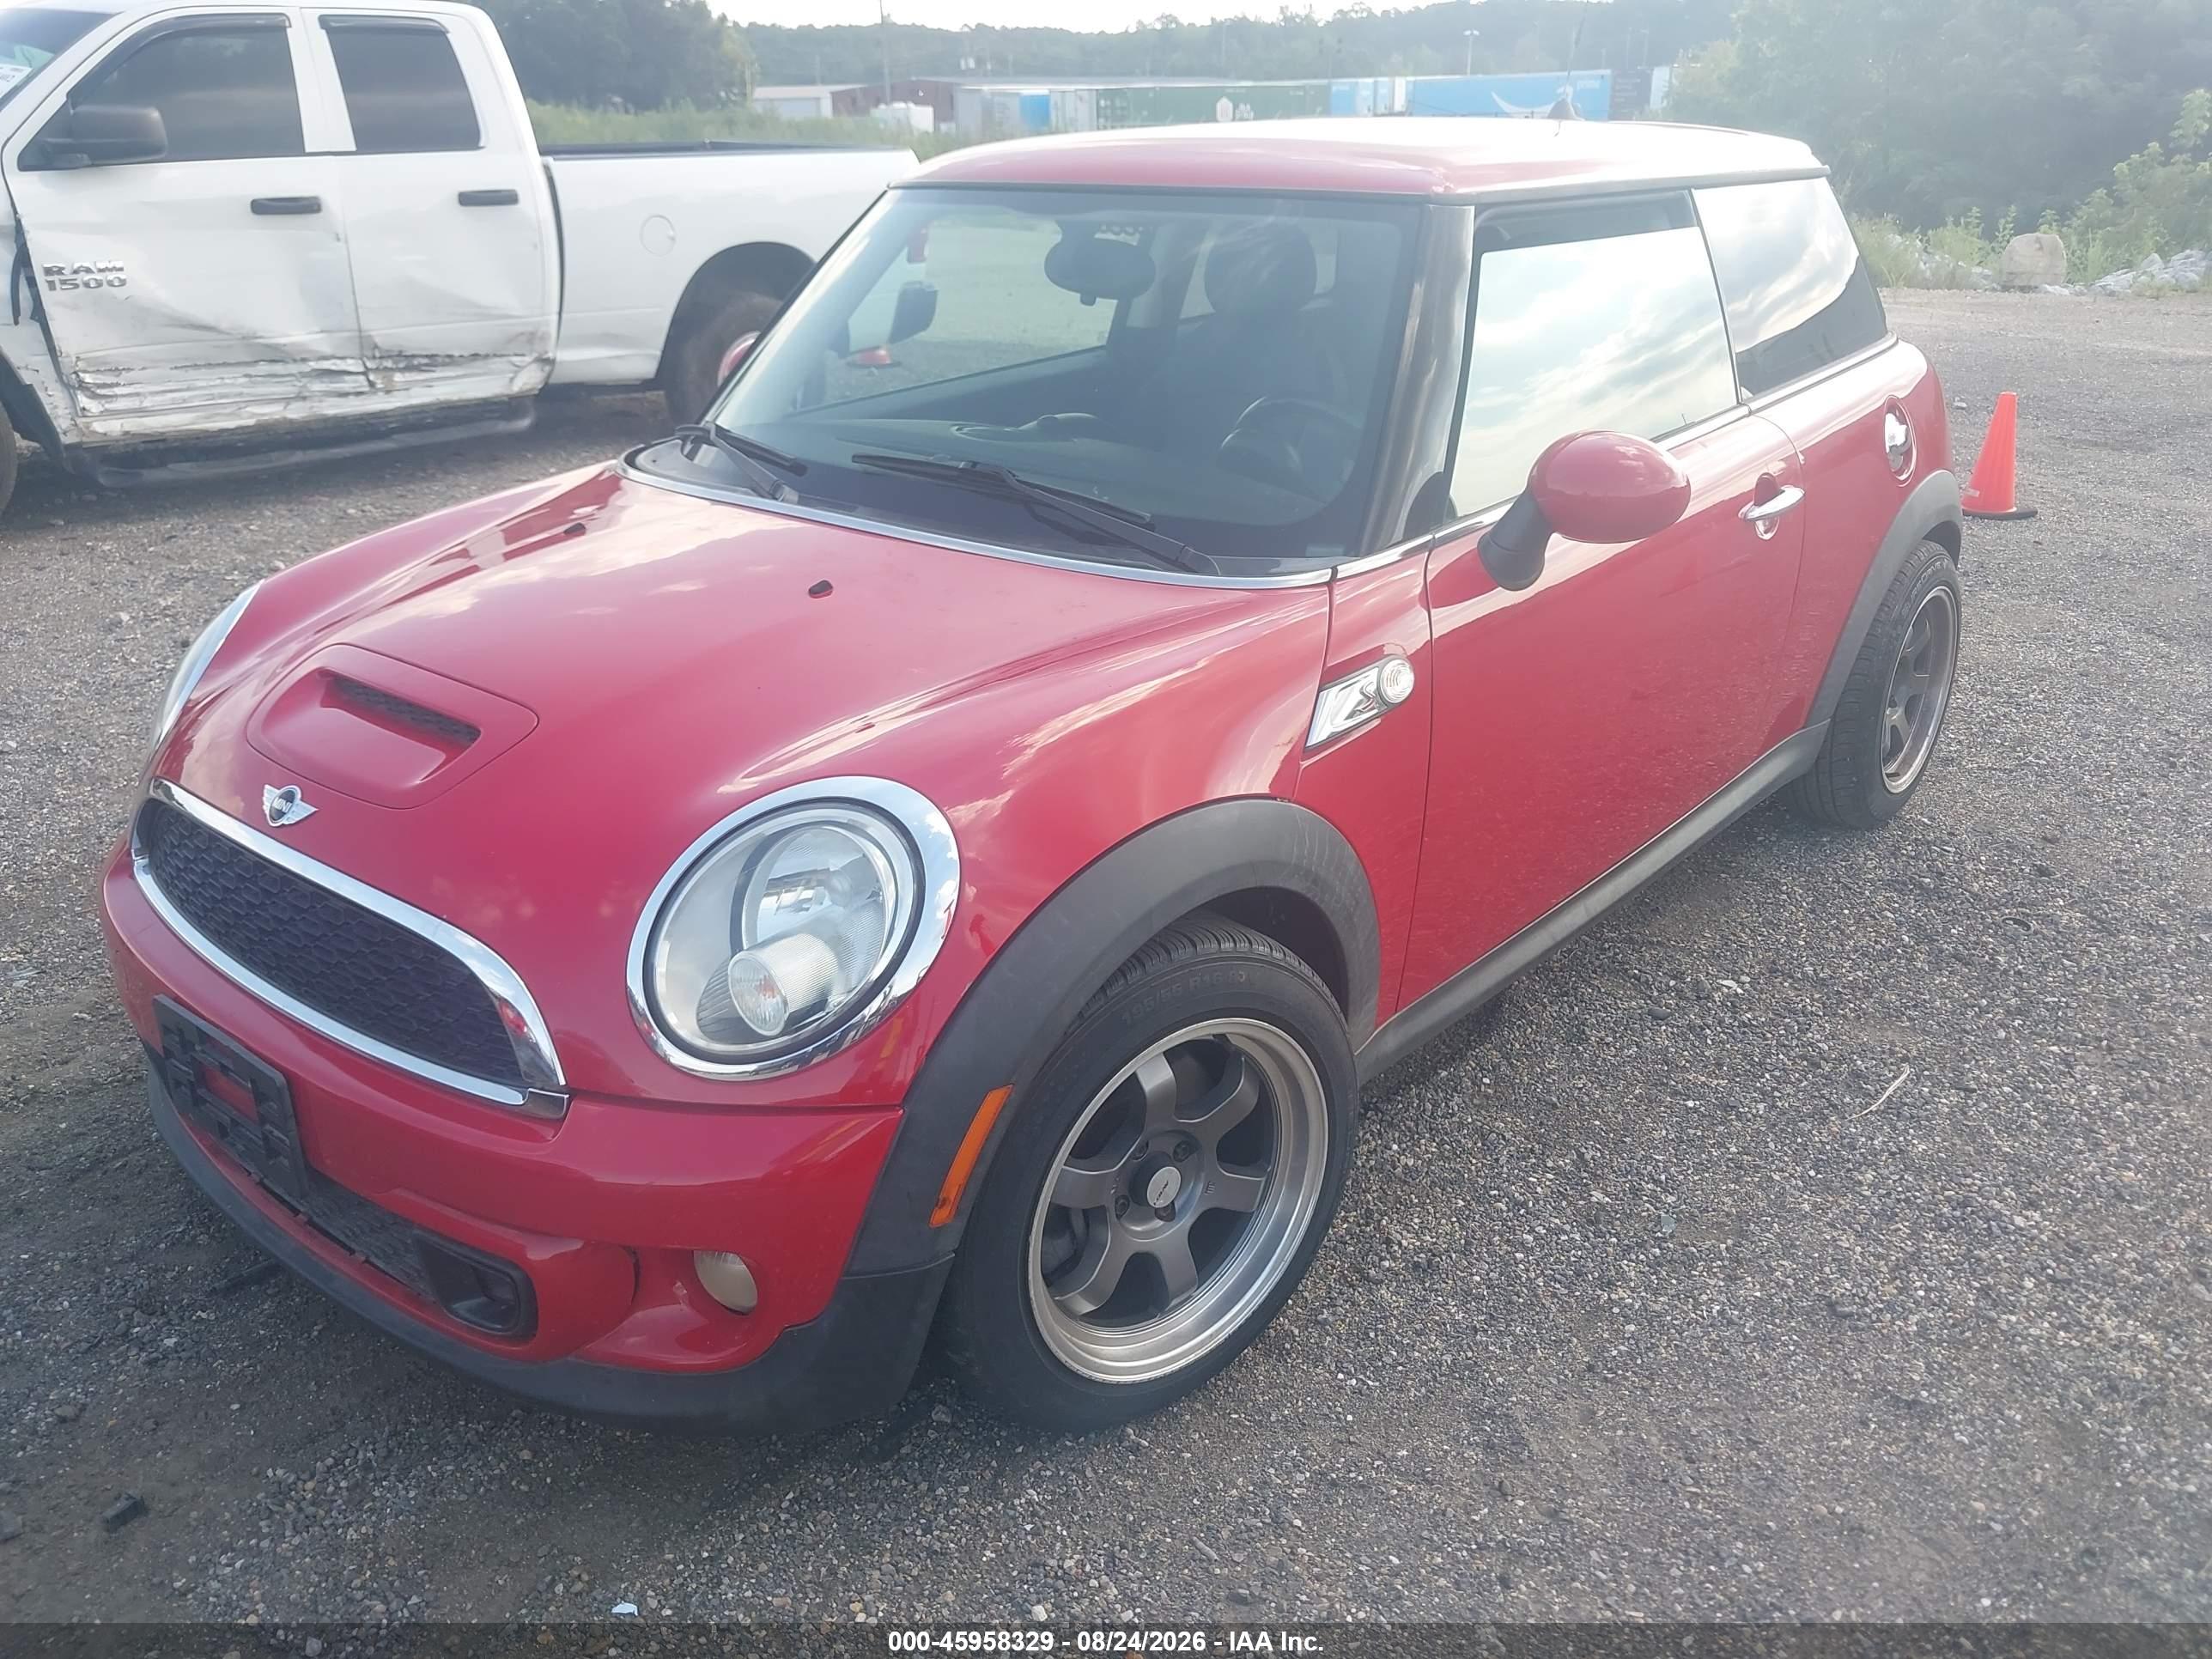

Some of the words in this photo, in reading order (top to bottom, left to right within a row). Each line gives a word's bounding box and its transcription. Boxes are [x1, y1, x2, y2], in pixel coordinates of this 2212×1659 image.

[43, 261, 125, 276] RAM
[45, 275, 128, 291] 1500
[271, 796, 293, 813] MINI
